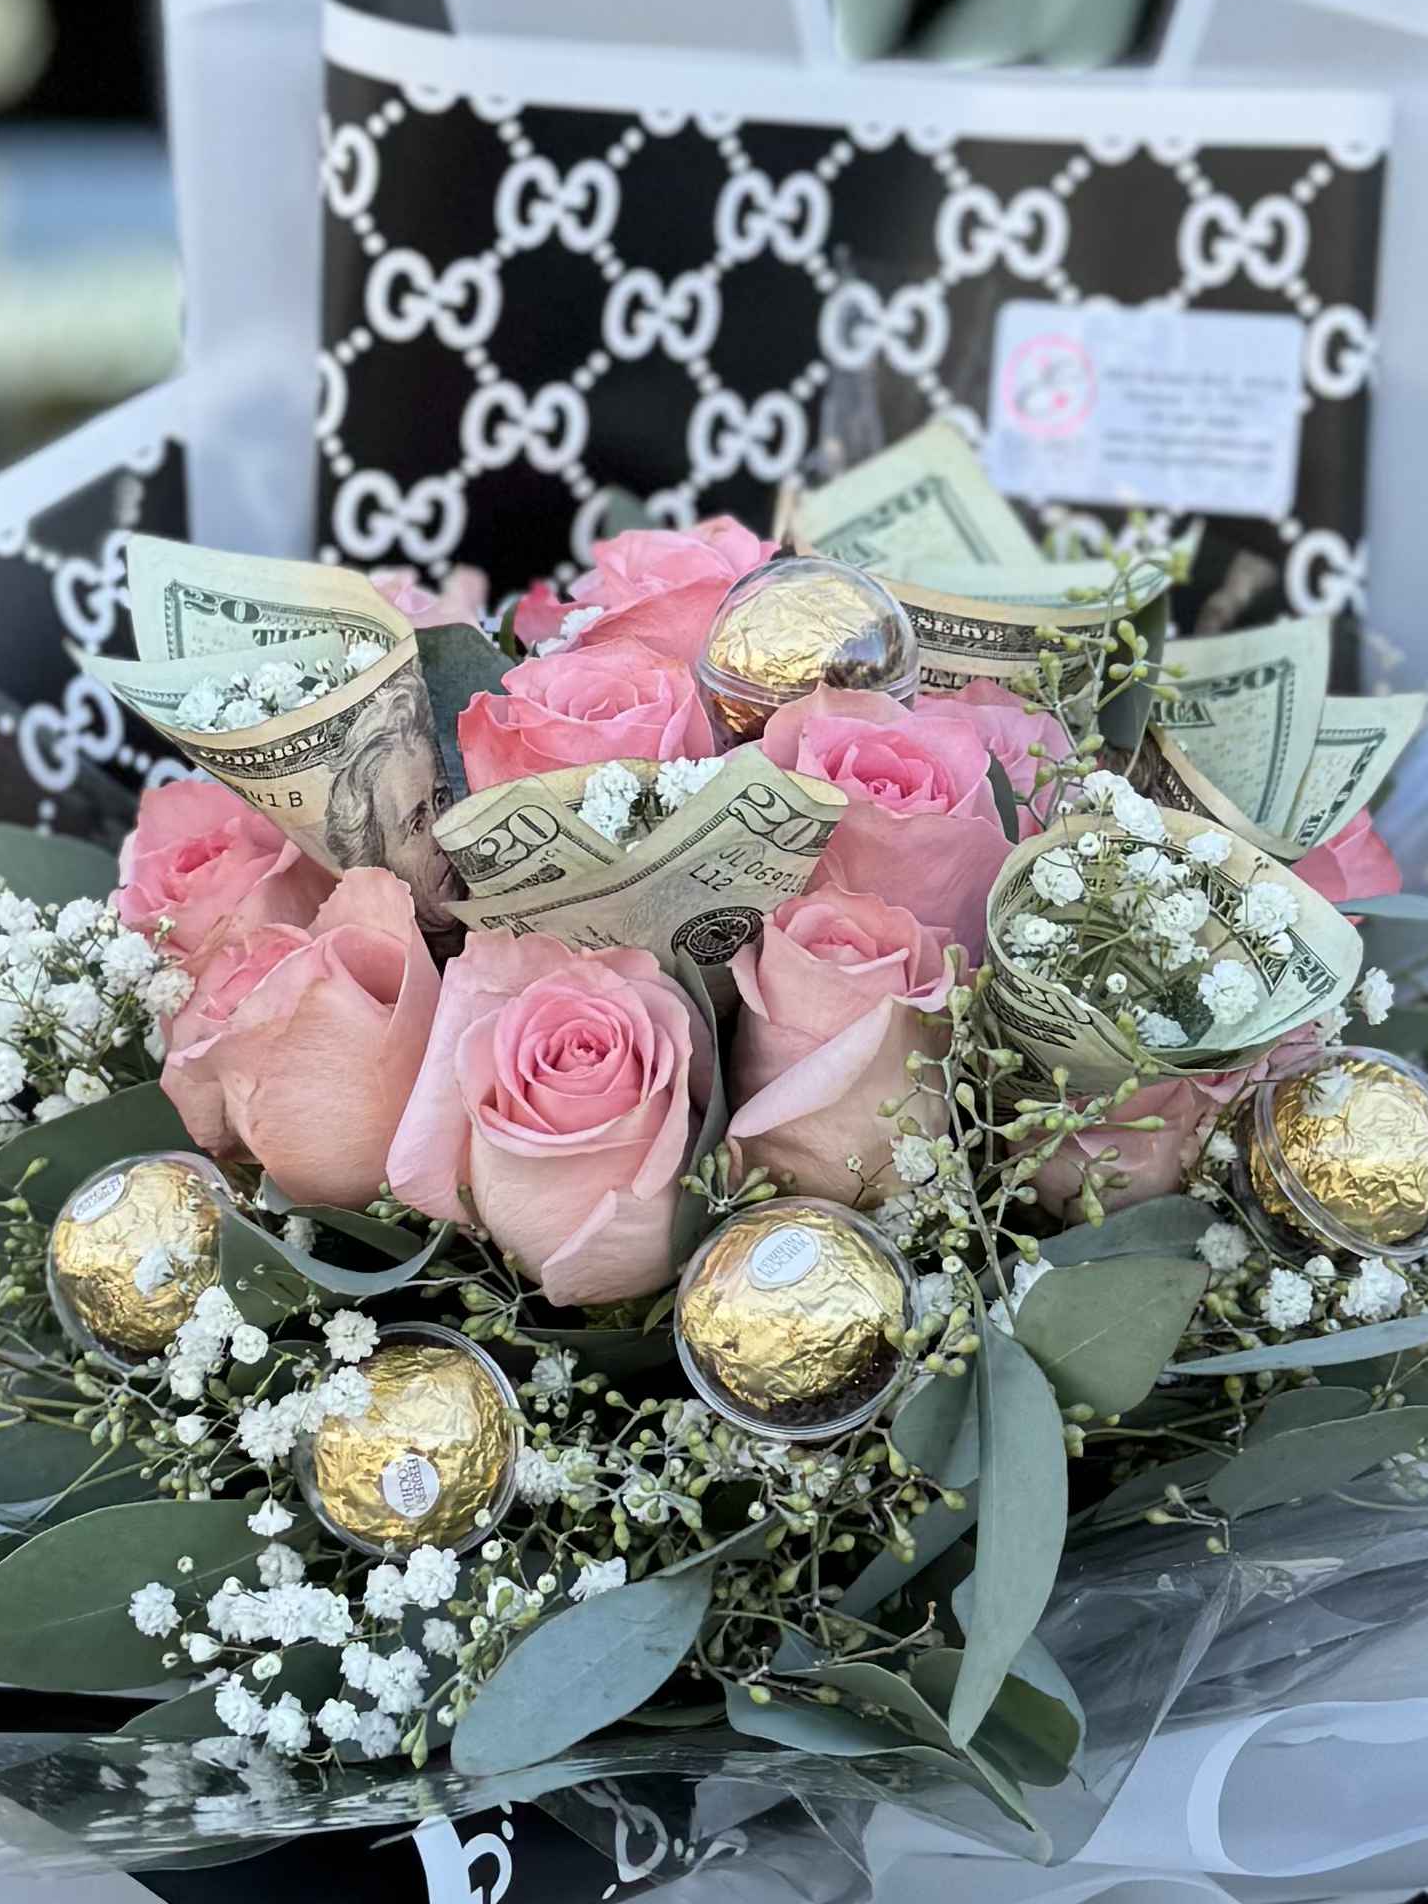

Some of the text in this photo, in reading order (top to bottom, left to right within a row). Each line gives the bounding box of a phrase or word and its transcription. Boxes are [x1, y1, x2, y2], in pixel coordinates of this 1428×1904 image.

[477, 804, 561, 868] 20
[728, 782, 822, 852] 20
[688, 862, 734, 892] L12
[1290, 953, 1332, 995] 20
